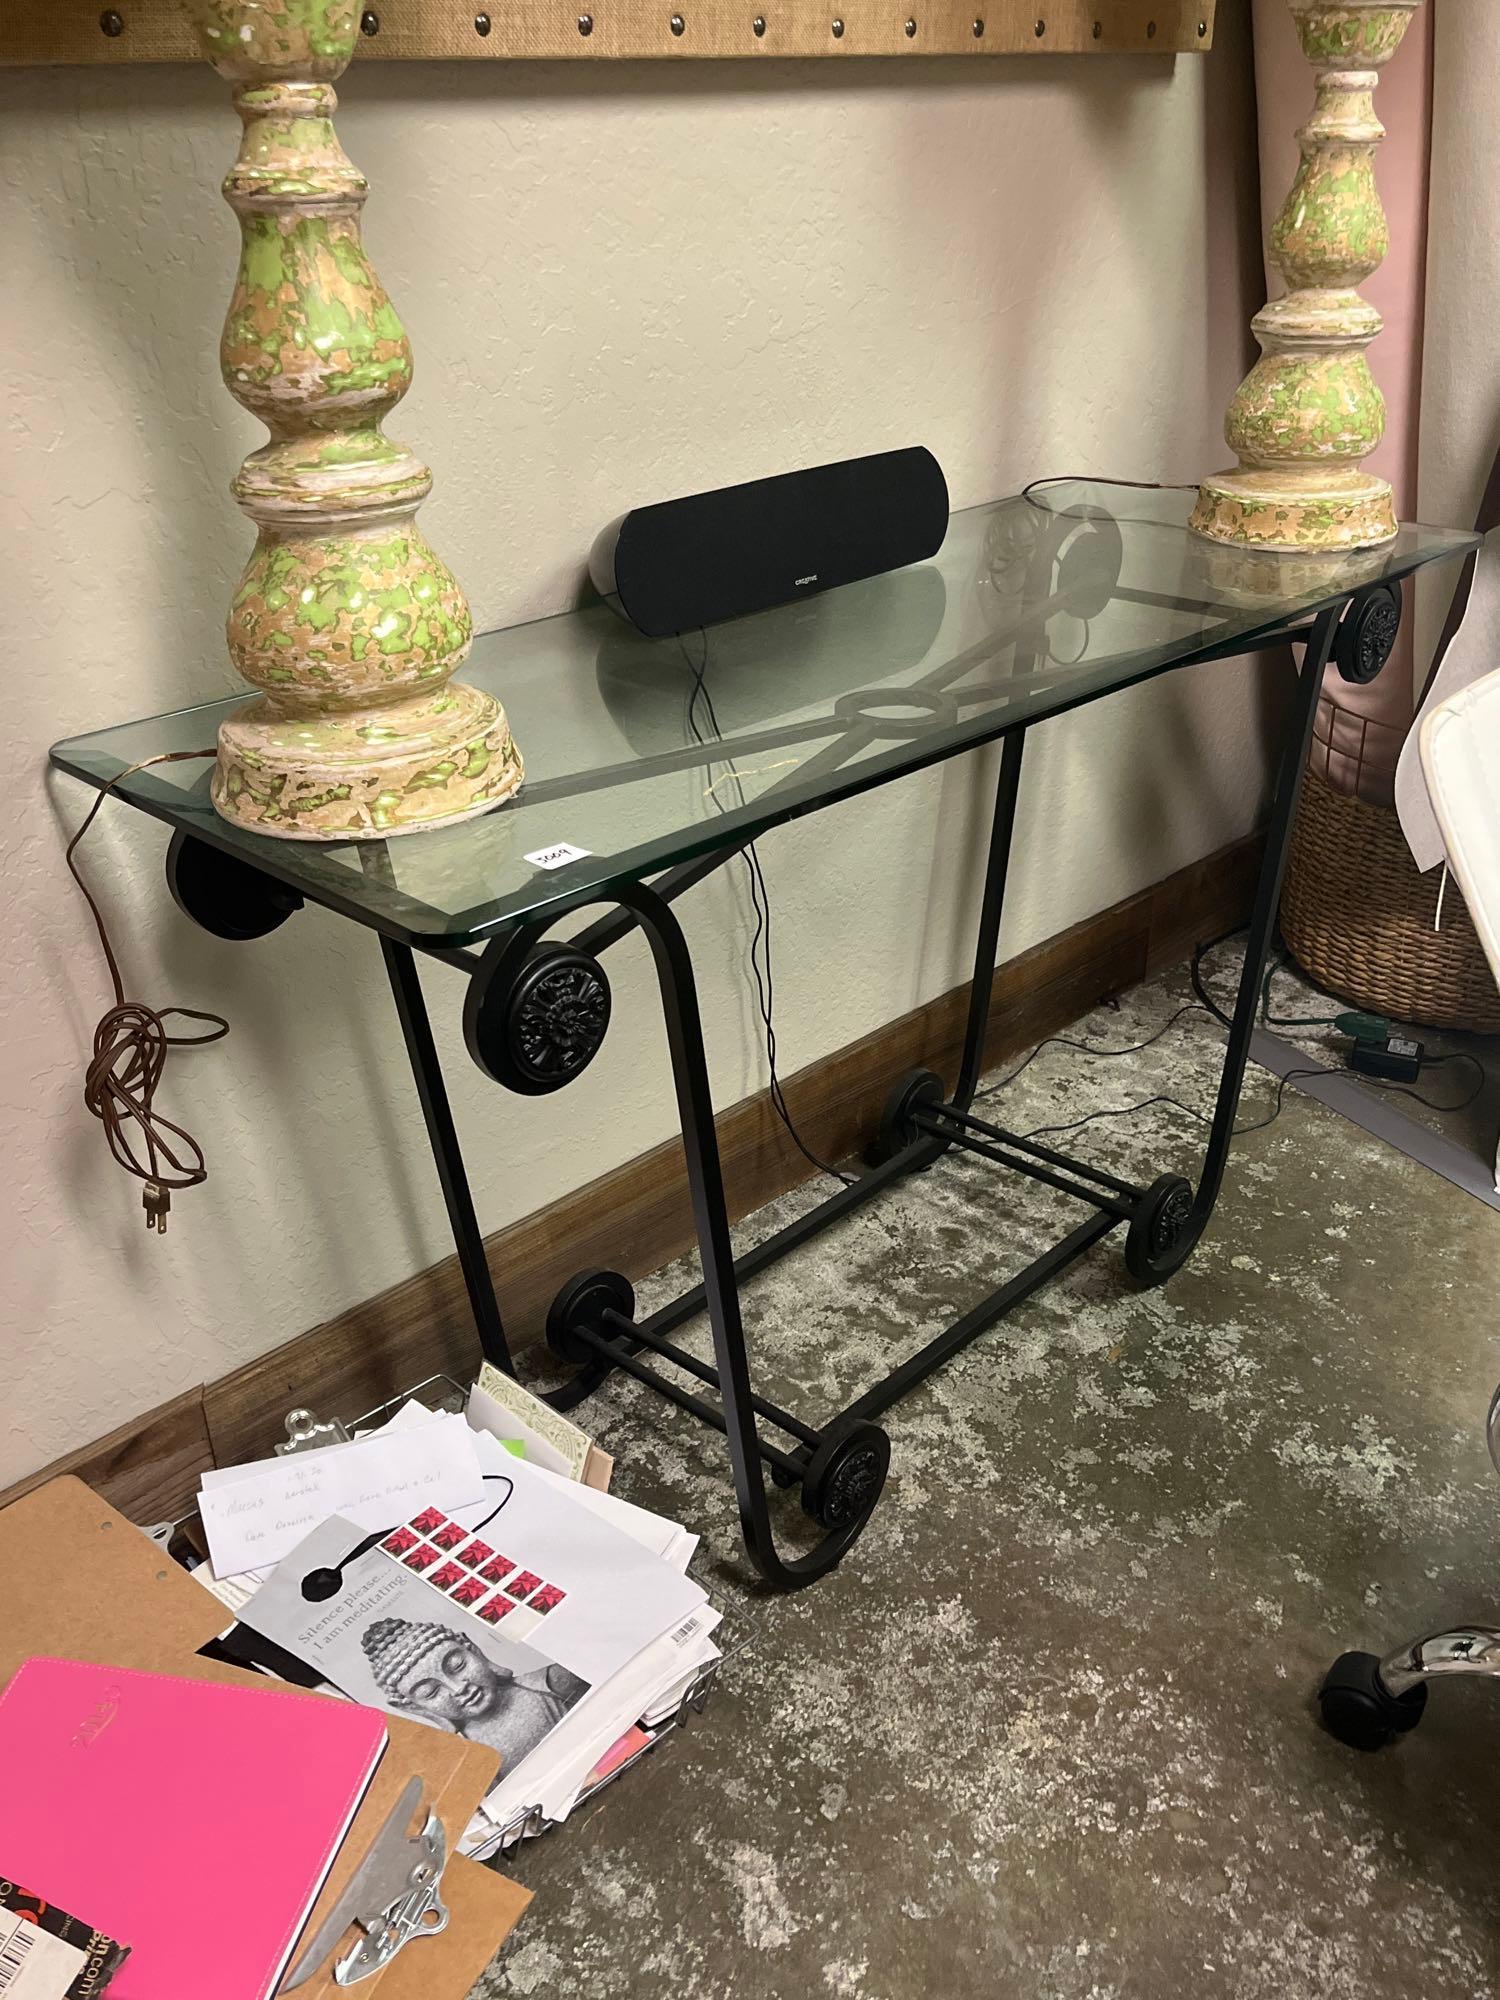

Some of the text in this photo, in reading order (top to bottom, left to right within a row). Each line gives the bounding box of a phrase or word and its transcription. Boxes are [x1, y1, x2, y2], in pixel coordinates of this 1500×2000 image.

[298, 1605, 345, 1644] Silence
[313, 1641, 323, 1650] I
[321, 1626, 344, 1644] am
[342, 1574, 409, 1628] meditating.
